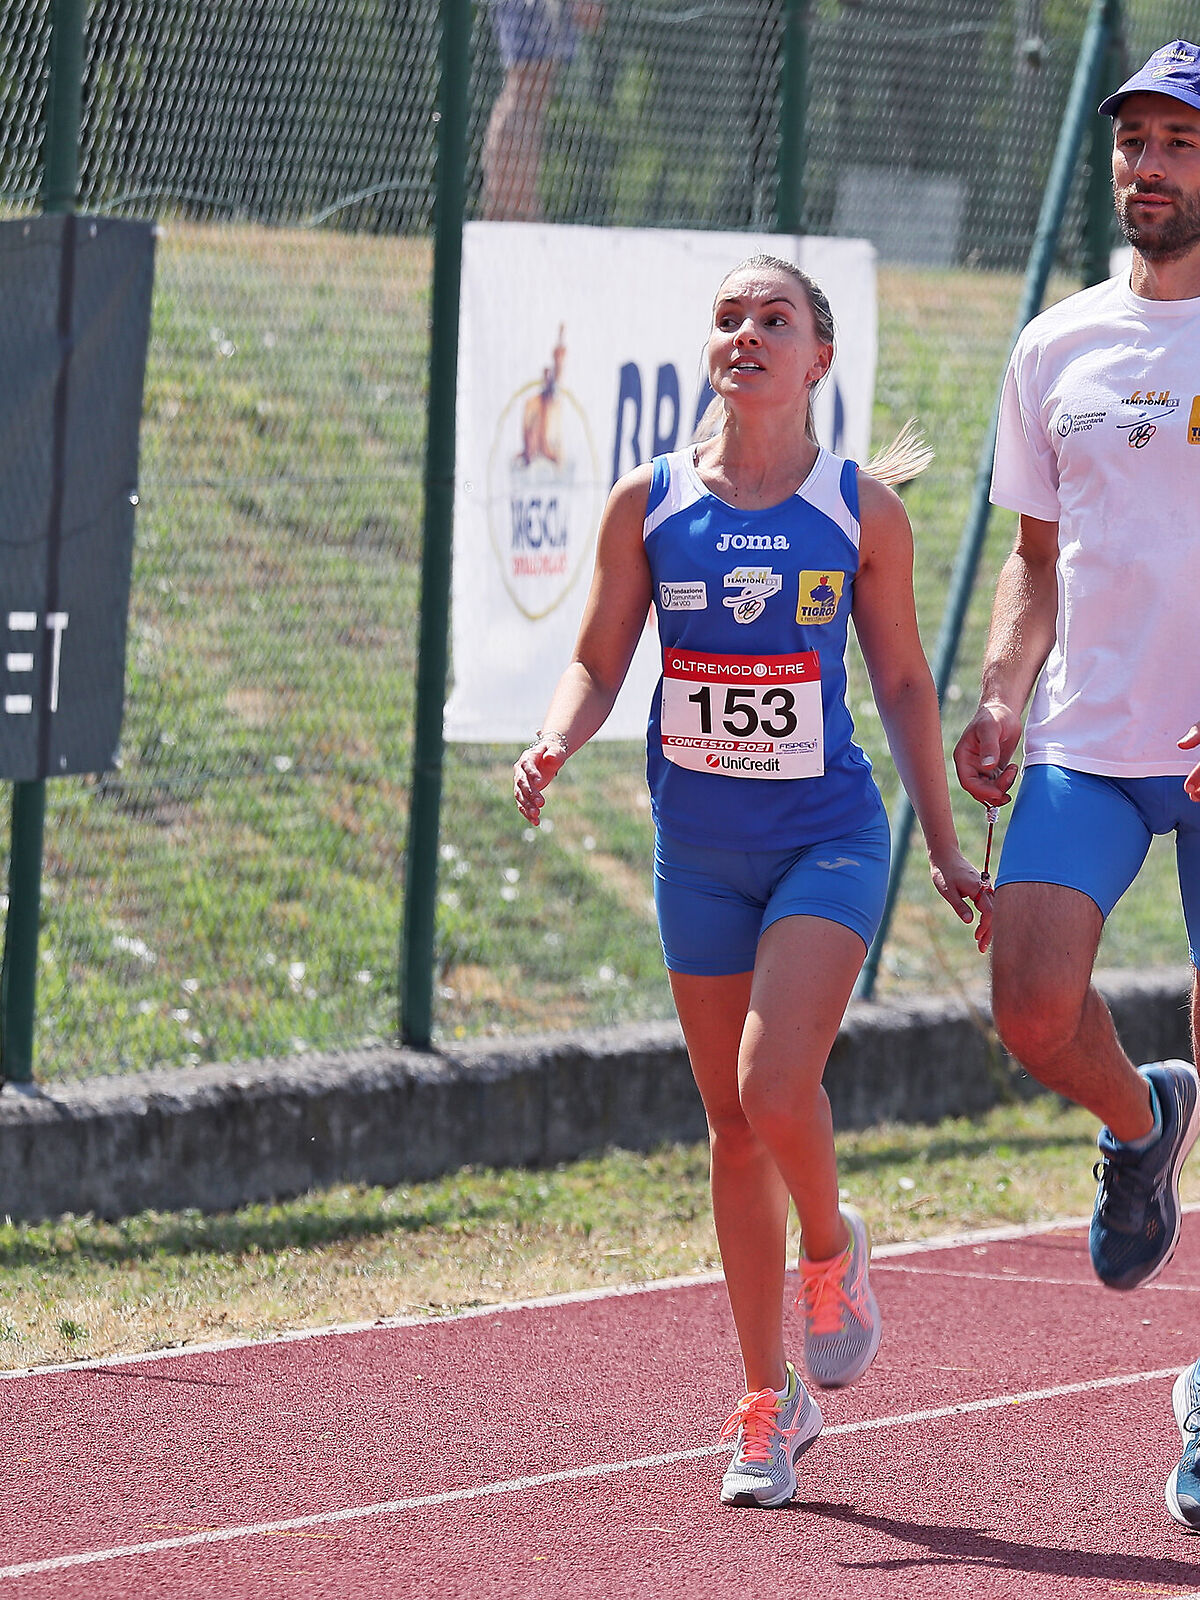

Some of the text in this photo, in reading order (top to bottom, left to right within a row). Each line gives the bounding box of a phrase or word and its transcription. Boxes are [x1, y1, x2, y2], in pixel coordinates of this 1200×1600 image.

[1121, 398, 1166, 406] SEMPIONE
[1073, 418, 1104, 426] Comunitaria
[1074, 412, 1106, 420] Fondazione
[716, 533, 790, 552] Joma
[801, 606, 836, 617] TIGROS
[688, 686, 798, 738] 153
[667, 737, 735, 750] CONCESIO
[737, 743, 772, 752] 2021
[721, 756, 781, 772] UniCredit
